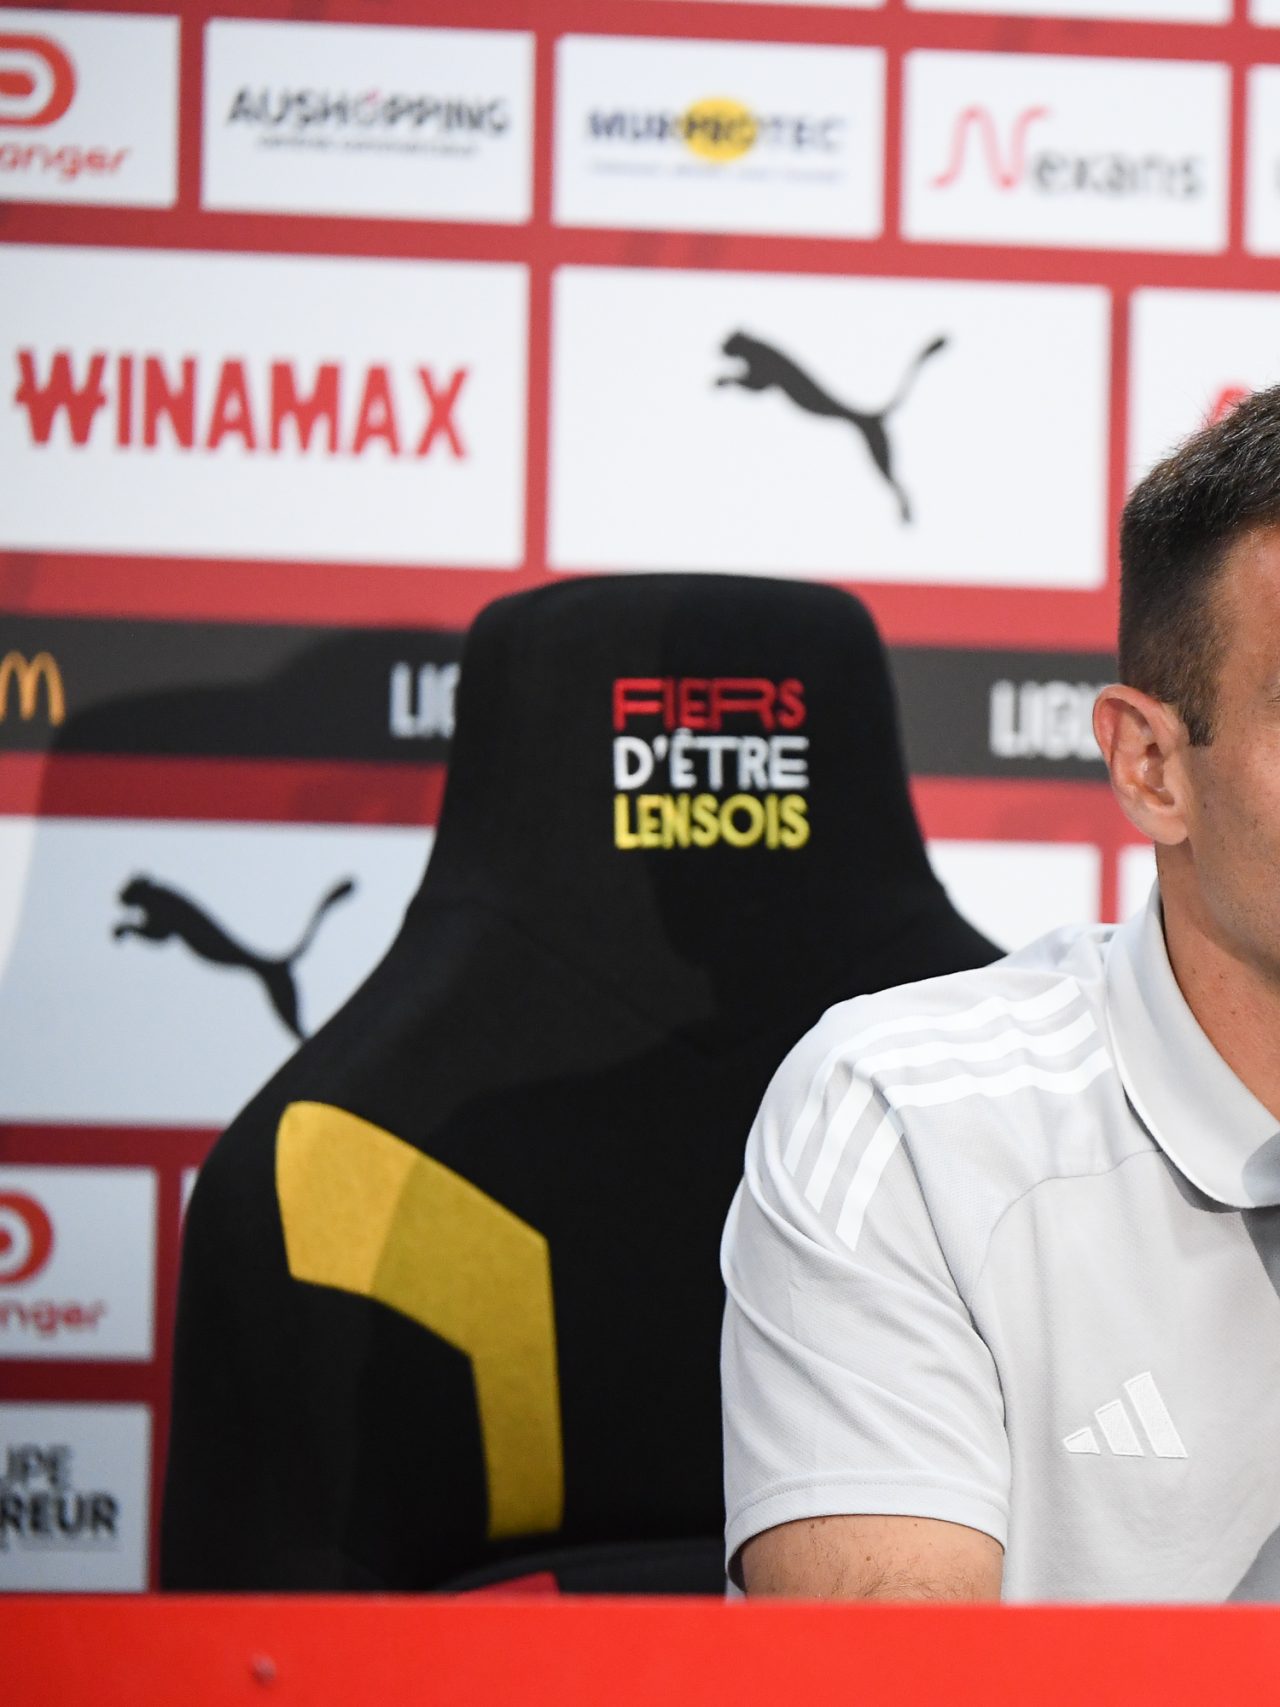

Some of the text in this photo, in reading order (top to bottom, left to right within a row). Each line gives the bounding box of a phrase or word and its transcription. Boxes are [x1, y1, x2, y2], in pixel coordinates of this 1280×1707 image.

[930, 104, 1203, 199] Nexans
[15, 348, 470, 460] WINAMAX
[612, 677, 807, 732] FIERS
[612, 727, 810, 790] D'ÊTRE
[613, 793, 811, 850] LENSOIS
